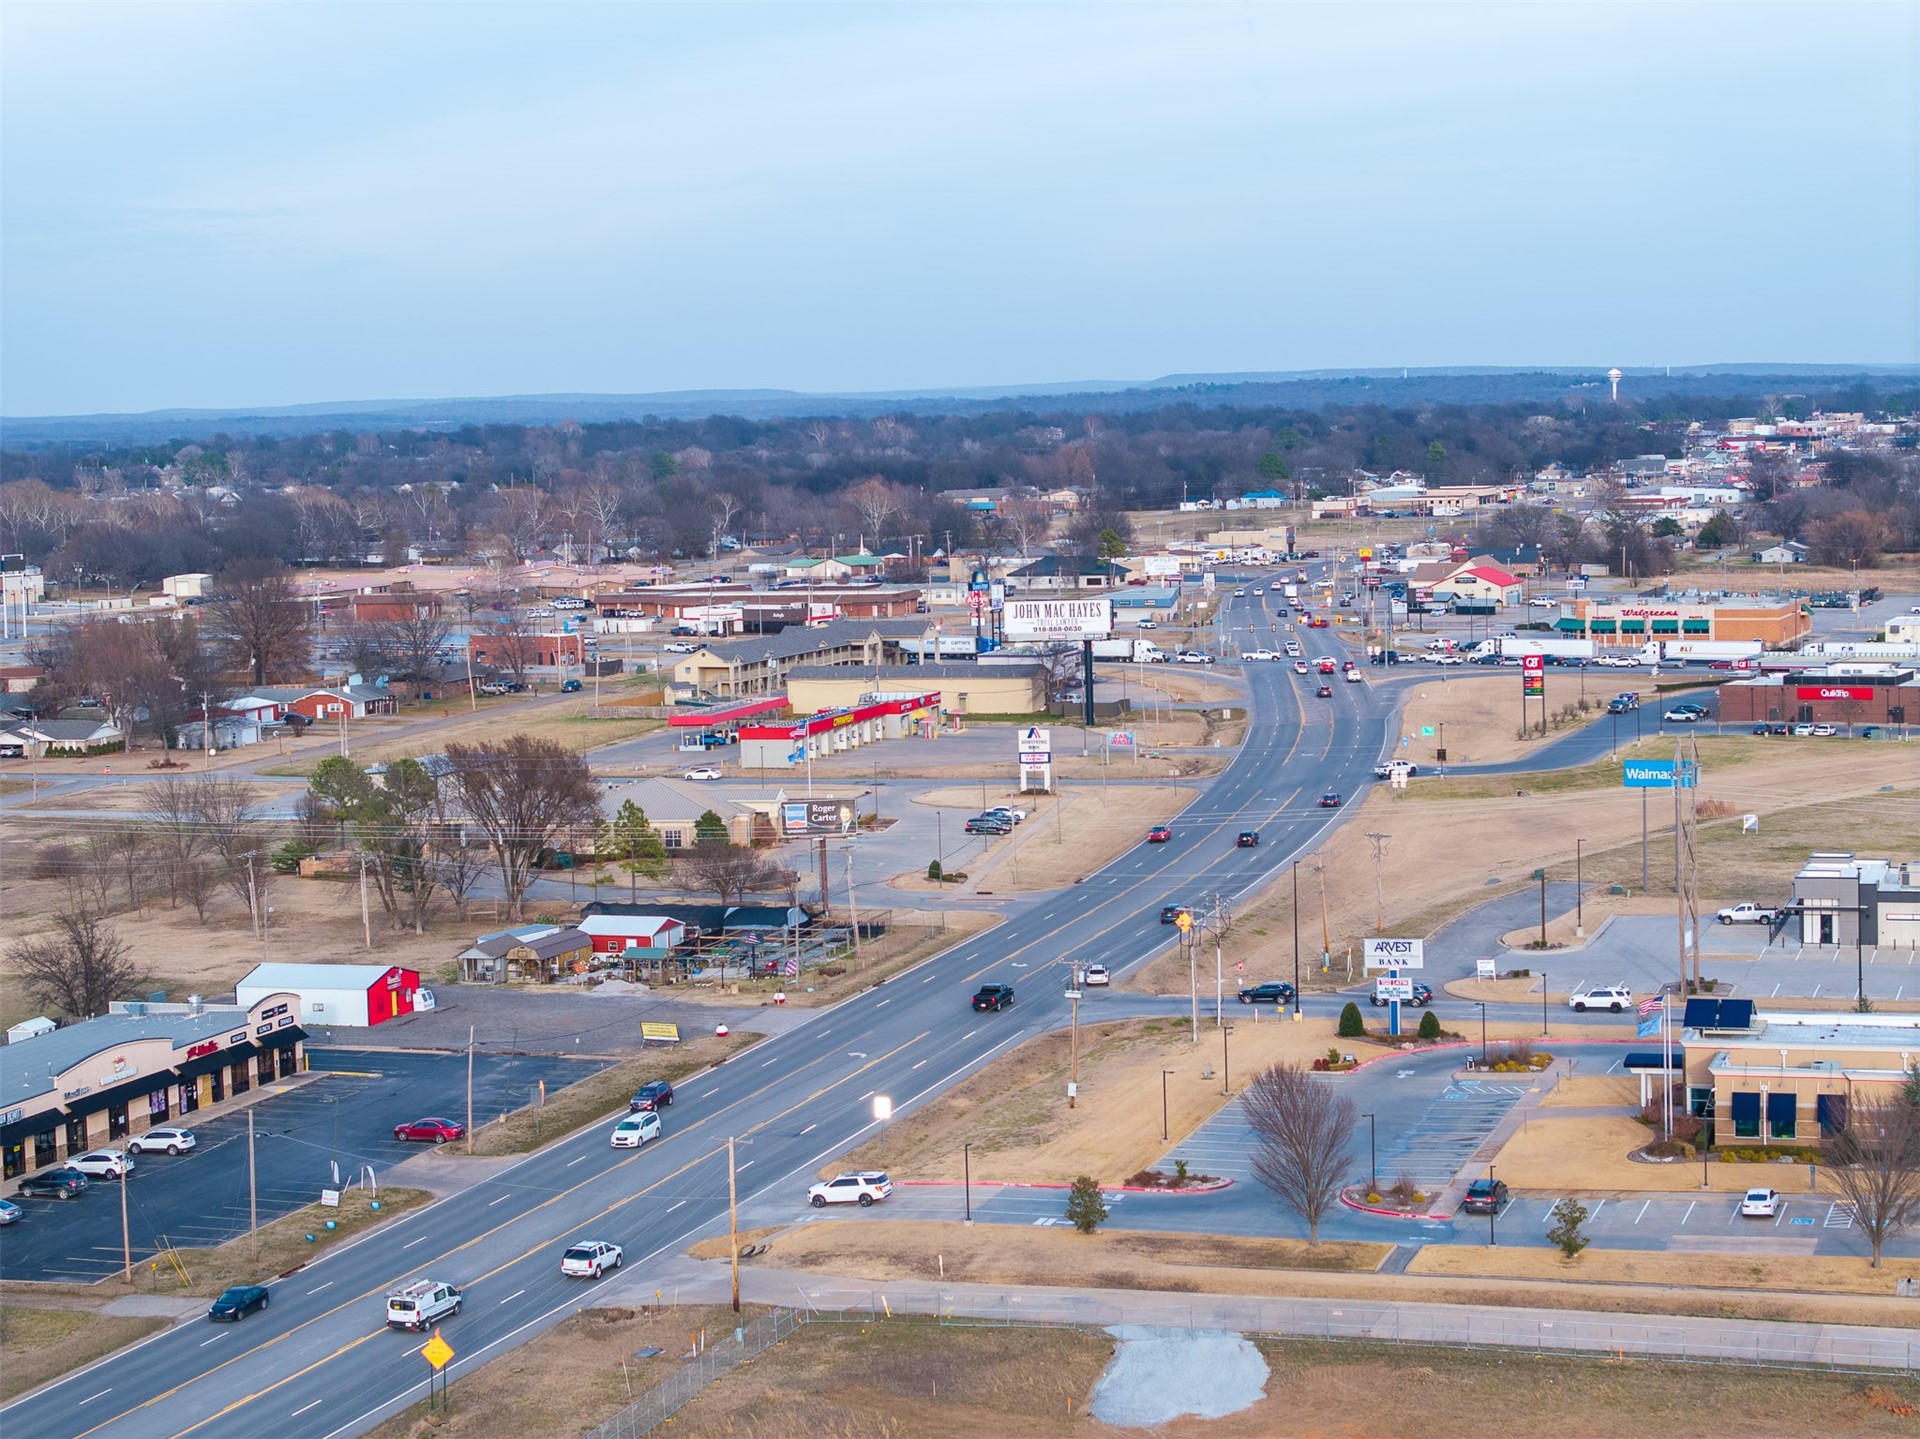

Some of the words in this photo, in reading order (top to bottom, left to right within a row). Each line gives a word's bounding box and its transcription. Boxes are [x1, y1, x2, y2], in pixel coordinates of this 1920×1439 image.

[1013, 604, 1040, 619] JOHN
[1045, 604, 1065, 618] MAC
[1069, 603, 1102, 617] HAYES
[1621, 608, 1678, 618] Walgreens
[1056, 618, 1078, 626] LAWYER
[1525, 657, 1540, 668] QT
[1820, 688, 1850, 698] QuikTrip
[812, 804, 836, 814] Roger
[811, 813, 837, 822] Carter
[1374, 941, 1413, 955] ARVEST
